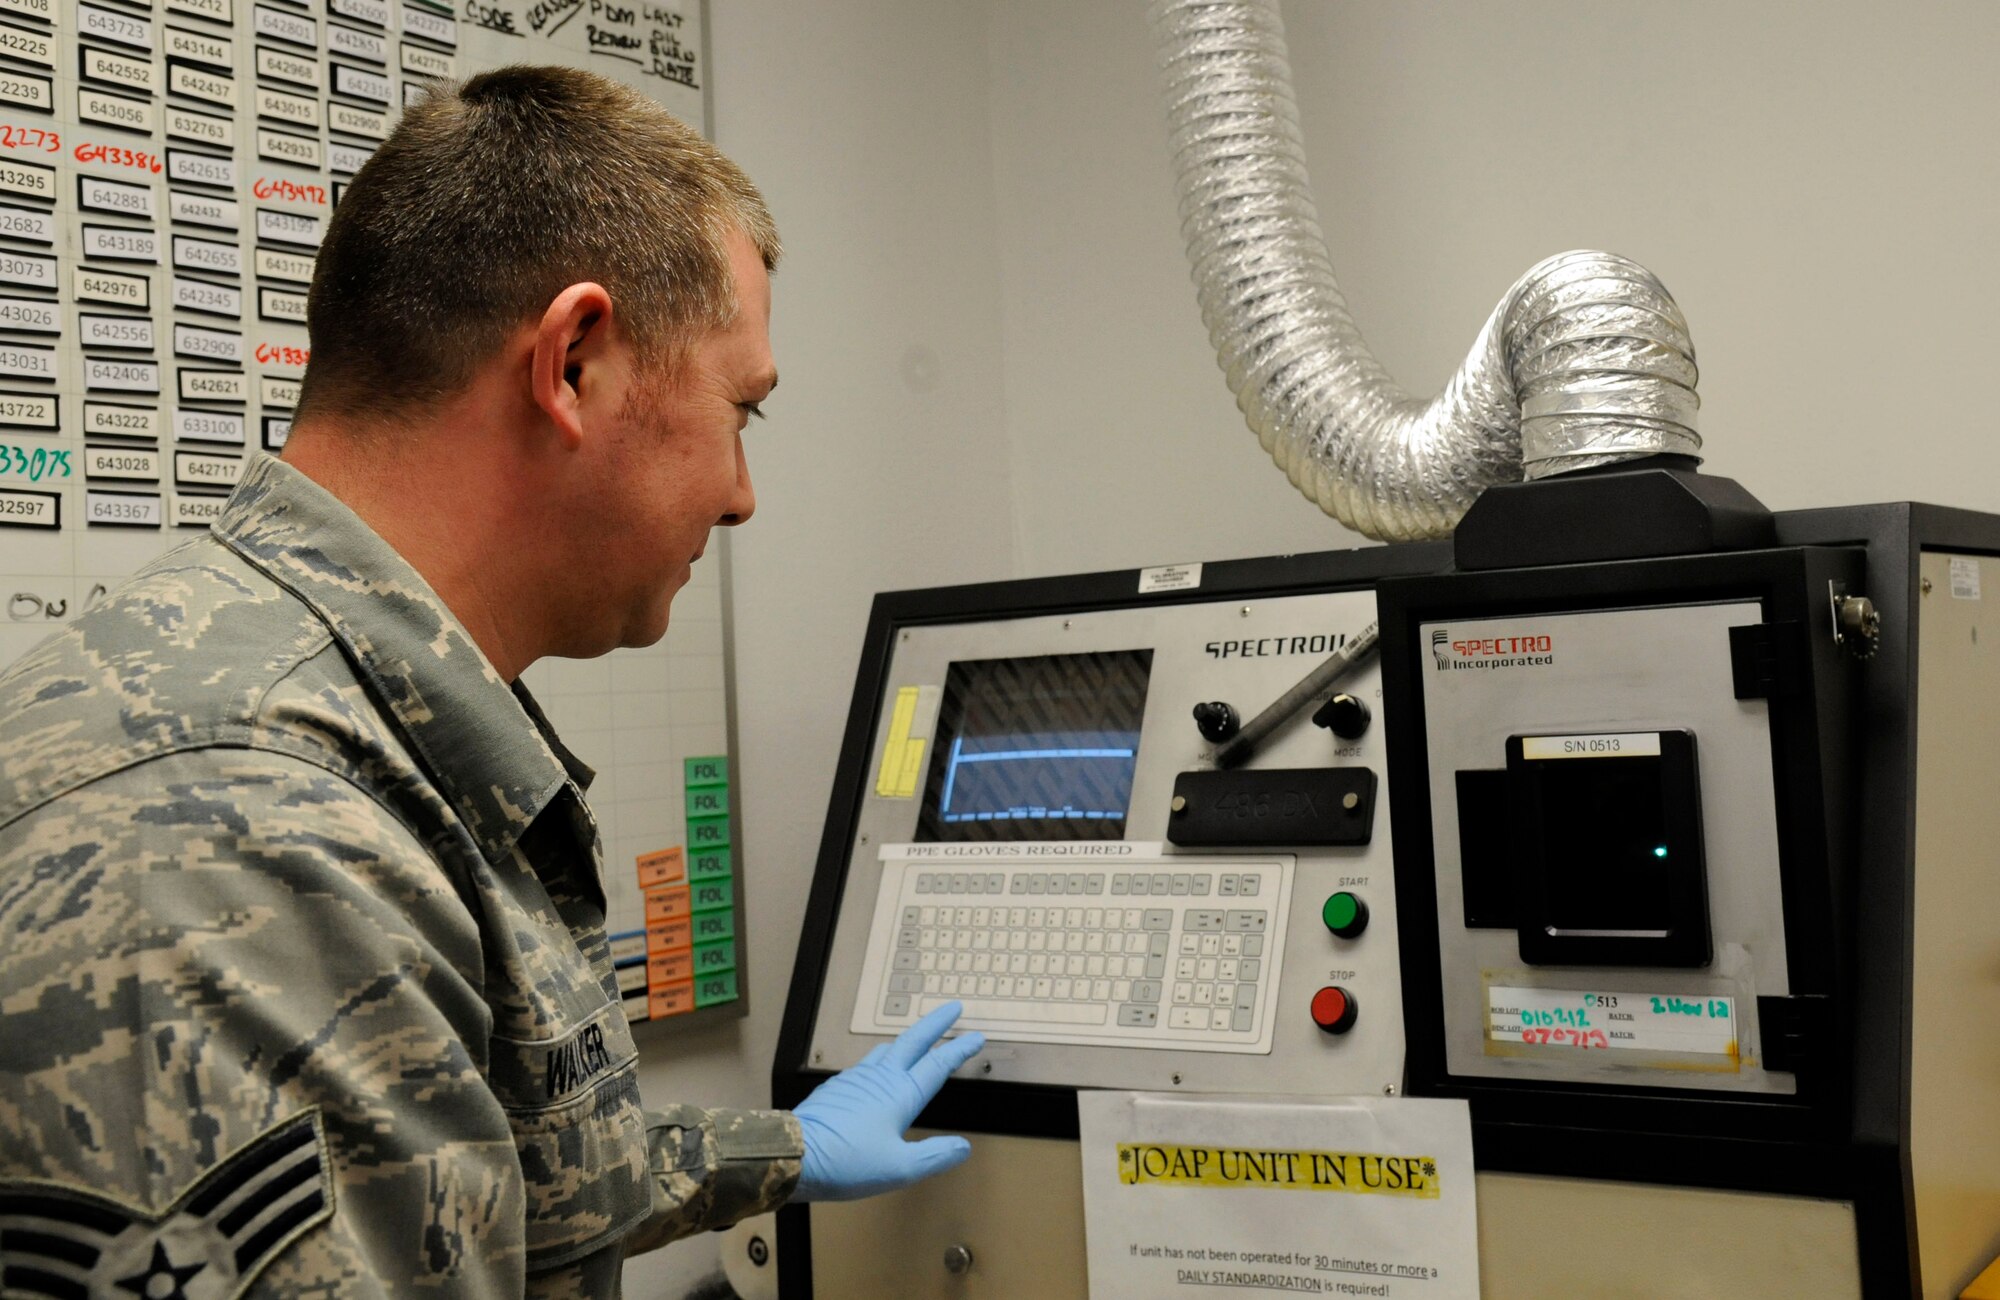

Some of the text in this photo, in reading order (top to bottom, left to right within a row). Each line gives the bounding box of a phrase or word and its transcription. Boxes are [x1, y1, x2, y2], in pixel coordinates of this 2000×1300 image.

[466, 0, 515, 33] CODE
[526, 0, 579, 31] REAS
[643, 4, 685, 29] LAST
[88, 14, 145, 39] 643723
[263, 15, 310, 40] 642801
[652, 29, 680, 45] OIL
[173, 37, 223, 58] 643144
[649, 39, 695, 63] BURN
[96, 60, 150, 83] 642552
[652, 58, 694, 83] DATE
[1, 81, 39, 99] 2239
[181, 75, 230, 98] 642437
[90, 101, 144, 123] 643056
[264, 97, 311, 118] 643015
[174, 117, 224, 139] 632763
[0, 125, 60, 152] 2273
[74, 144, 162, 174] 643386
[178, 160, 231, 181] 642615
[92, 188, 149, 211] 642881
[181, 204, 222, 218] 642432
[0, 216, 44, 234] 2682
[97, 235, 154, 254] 643189
[185, 246, 237, 267] 642655
[84, 279, 138, 298] 642976
[178, 288, 232, 308] 642345
[0, 305, 52, 326] 43026
[92, 324, 149, 342] 642556
[183, 335, 236, 356] 632909
[0, 352, 48, 372] 43031
[92, 364, 150, 382] 642406
[191, 380, 240, 393] 642621
[96, 413, 149, 429] 643222
[183, 418, 237, 435] 633100
[96, 456, 150, 471] 643028
[188, 462, 237, 478] 642717
[94, 504, 150, 520] 643367
[1453, 635, 1551, 656] SPECTRO
[1453, 655, 1553, 670] Incorporated
[1334, 748, 1362, 757] MODE
[1564, 739, 1620, 754] S/N 0513
[694, 764, 720, 780] FOL
[695, 795, 720, 810] FOL
[696, 826, 722, 841] FOL
[906, 844, 1133, 857] PPE GLOVES REQUIRED
[698, 857, 723, 872] FOL
[1339, 877, 1369, 887] START
[699, 888, 724, 903] FOL
[701, 919, 726, 934] FOL
[702, 950, 727, 965] FOL
[1329, 970, 1356, 980] STOP
[703, 981, 729, 996] FOL
[1218, 1150, 1299, 1183] UNIT
[1312, 1154, 1346, 1186] IN
[1130, 1244, 1438, 1278] If unit has not been operated for 30 minutes or more a
[1177, 1269, 1390, 1298] DAILY STANDARDIZATION is required!
